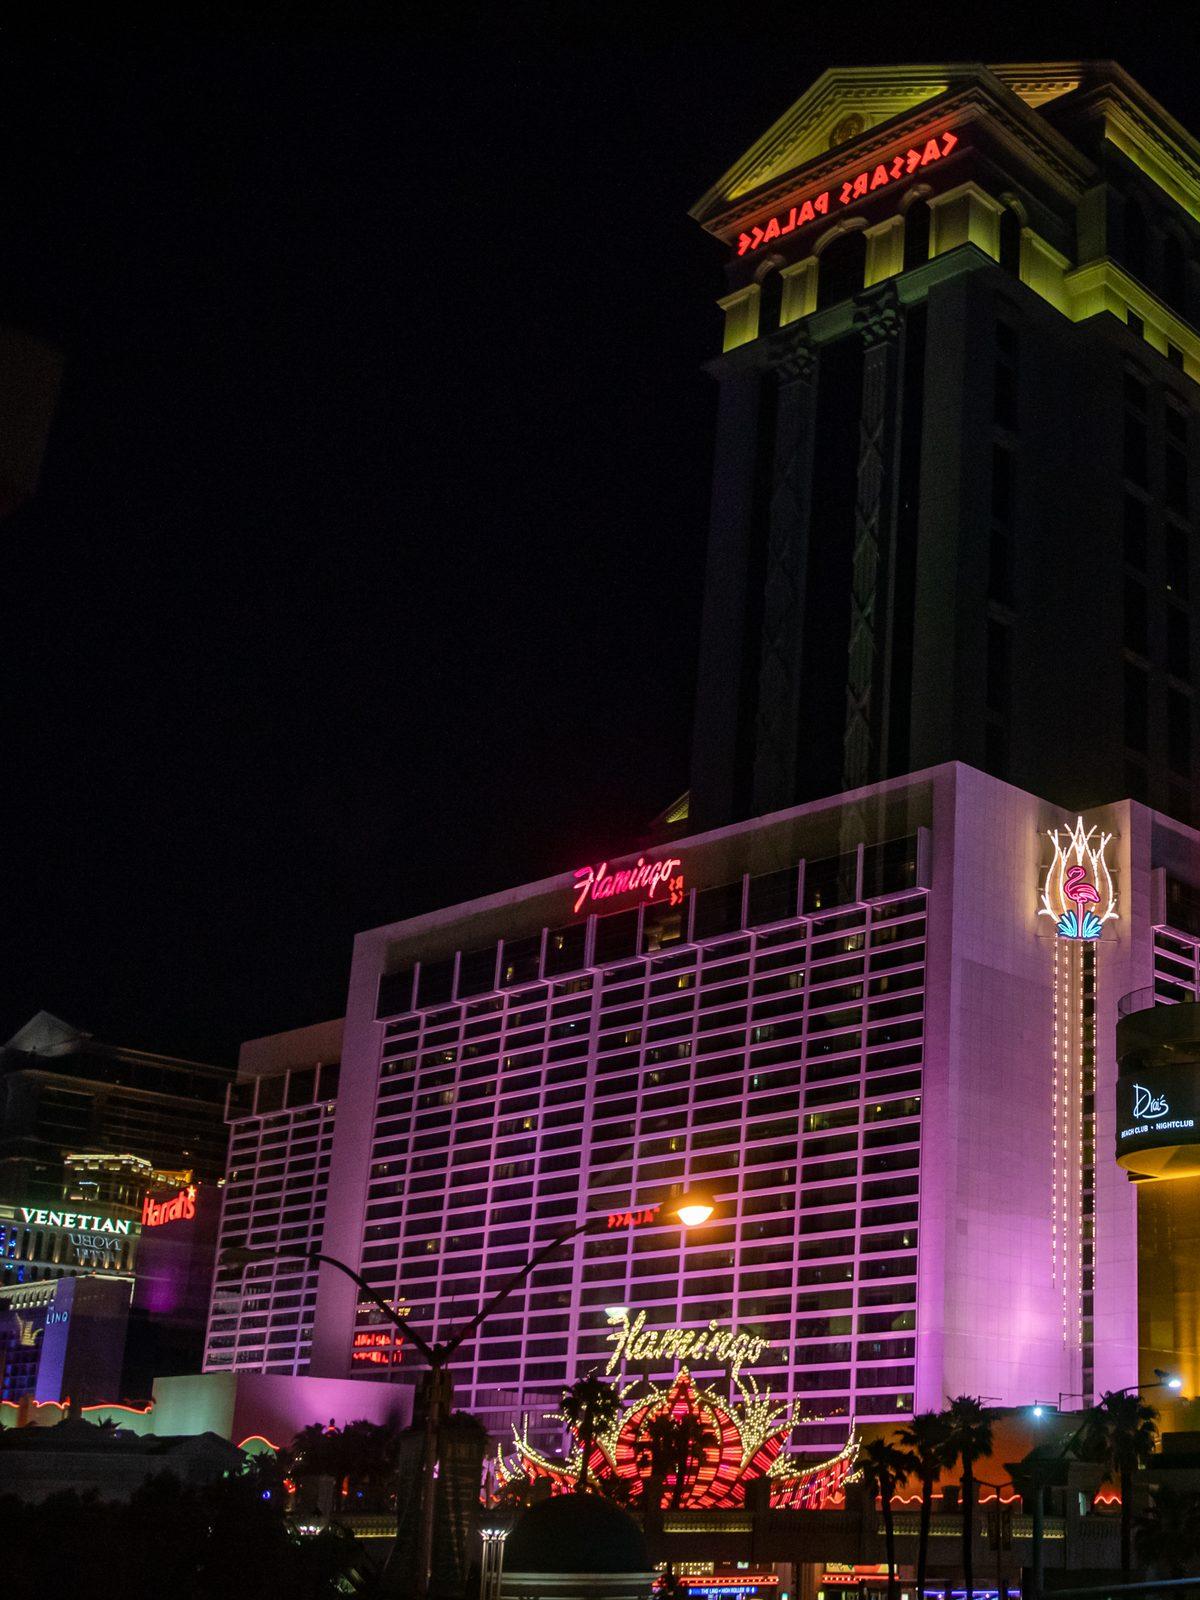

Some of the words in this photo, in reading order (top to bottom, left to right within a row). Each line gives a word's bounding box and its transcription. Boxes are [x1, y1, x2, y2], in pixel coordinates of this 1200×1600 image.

[573, 857, 681, 913] Flamingo
[1134, 1125, 1149, 1135] CLUB
[1155, 1119, 1194, 1130] NIGHTCLUB
[20, 1206, 132, 1236] VENETIAN
[46, 1311, 68, 1325] LINQ
[606, 1309, 770, 1381] Flamingo
